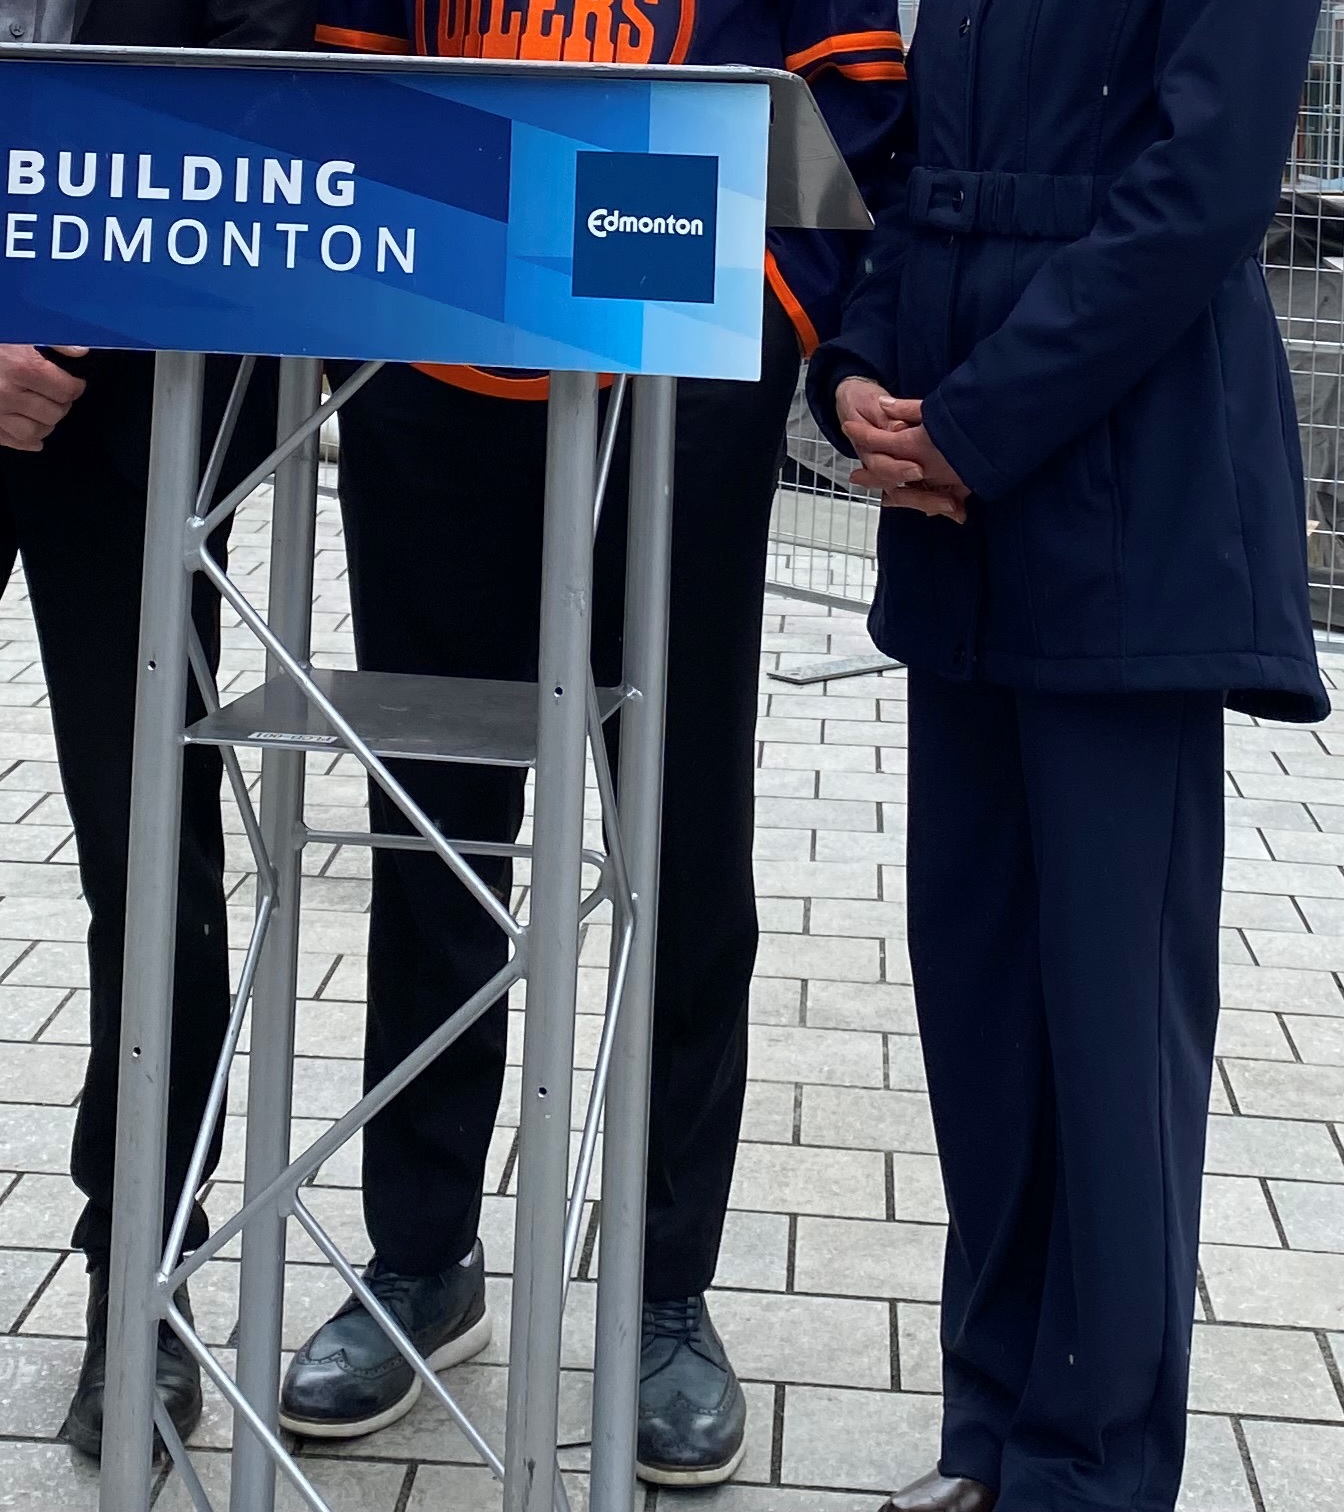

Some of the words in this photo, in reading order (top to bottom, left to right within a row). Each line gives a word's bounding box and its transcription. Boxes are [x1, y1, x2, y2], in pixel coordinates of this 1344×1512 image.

[7, 149, 356, 207] BUILDING
[4, 212, 417, 274] EDMONTON
[587, 208, 704, 238] Edmonton
